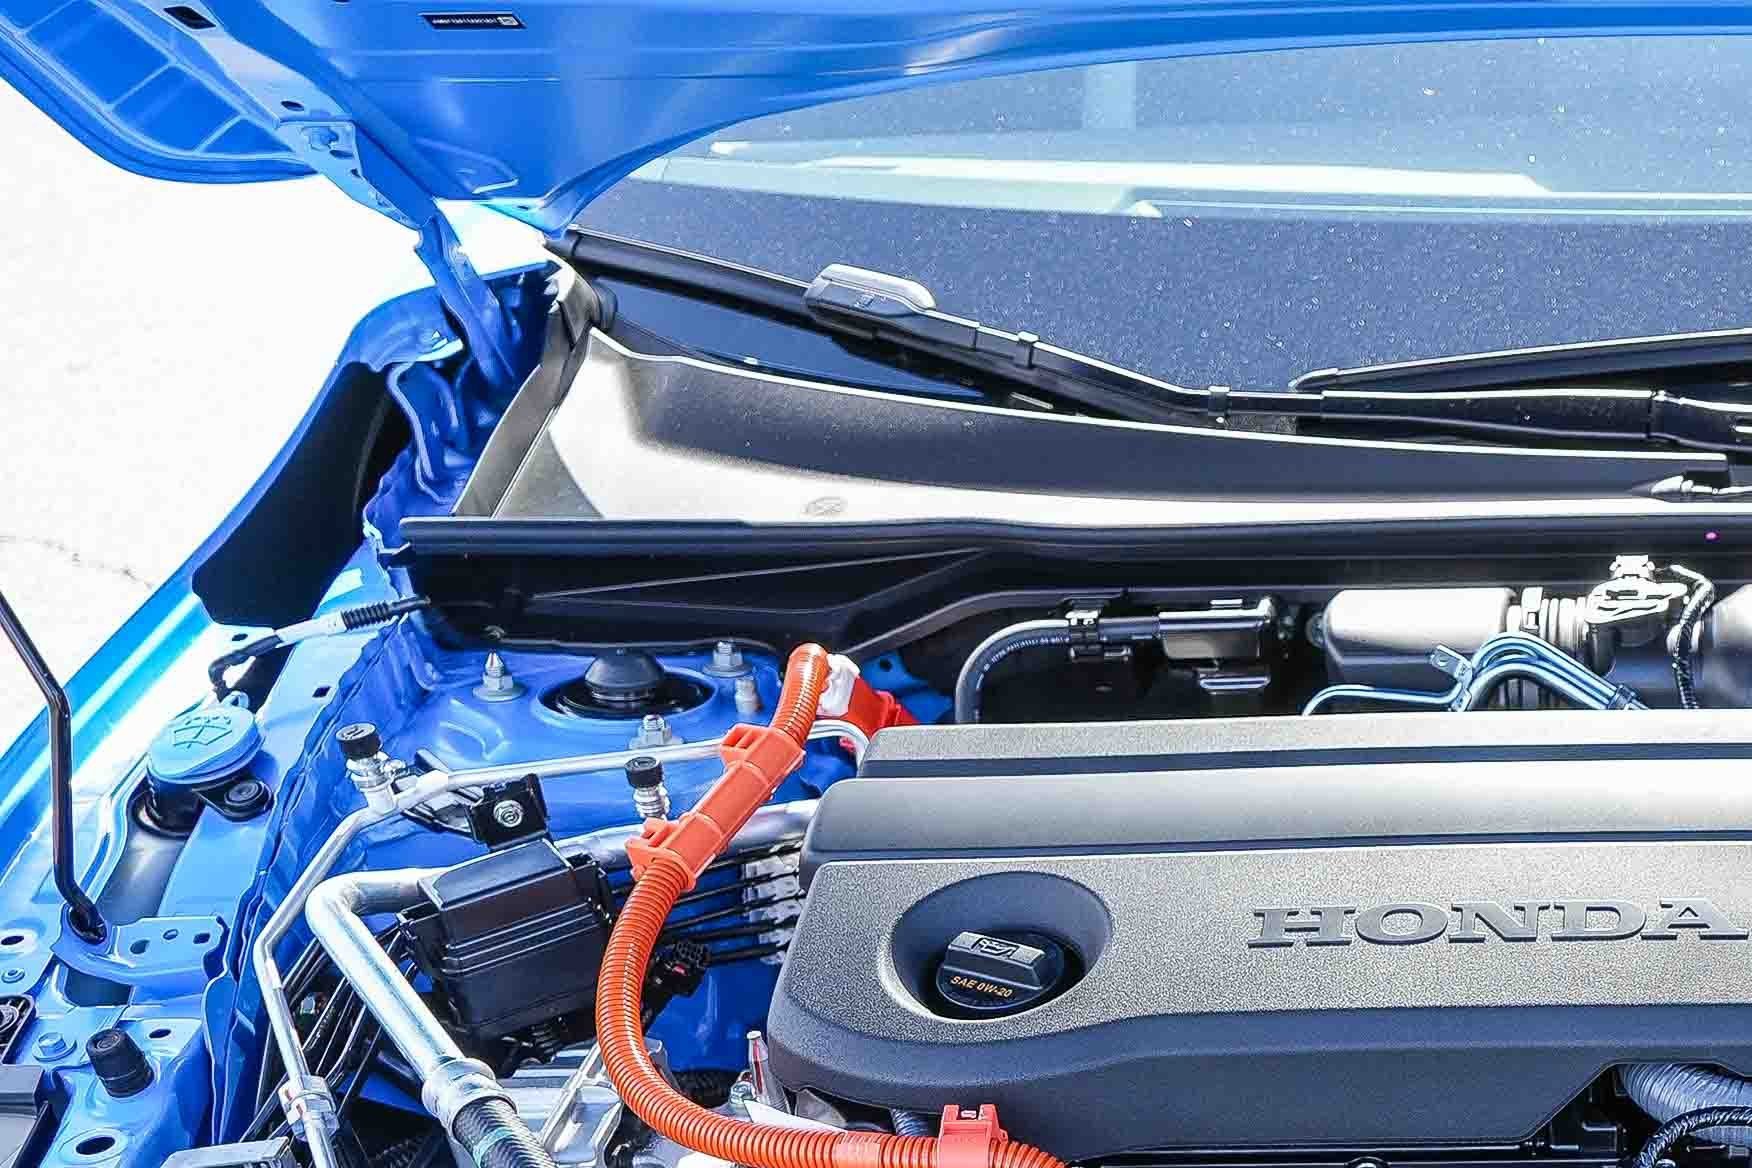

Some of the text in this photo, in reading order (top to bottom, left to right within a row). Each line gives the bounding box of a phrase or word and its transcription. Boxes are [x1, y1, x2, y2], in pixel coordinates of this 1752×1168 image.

[1248, 897, 1750, 948] HONDA
[950, 976, 1013, 997] SAE 0W-20
